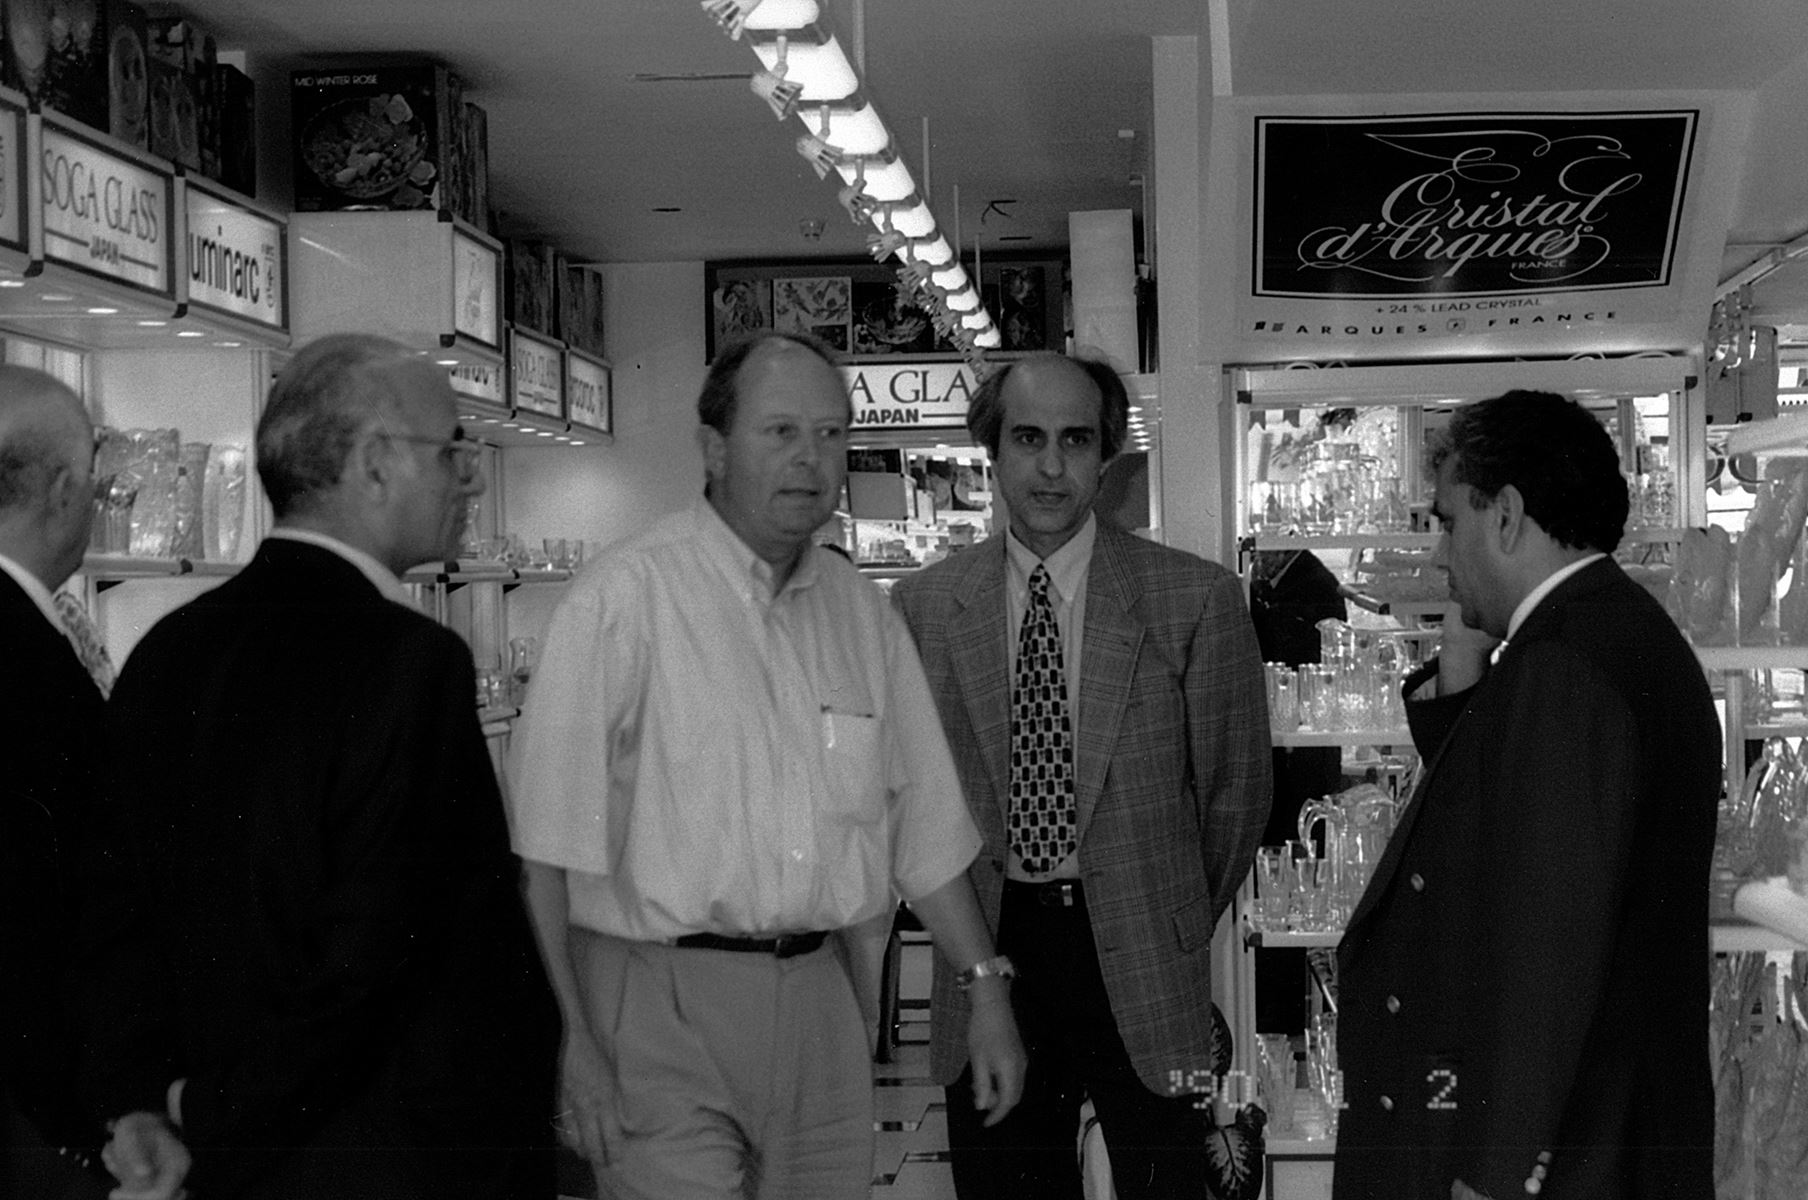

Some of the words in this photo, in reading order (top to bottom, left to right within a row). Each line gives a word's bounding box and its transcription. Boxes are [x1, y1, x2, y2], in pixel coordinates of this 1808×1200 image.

[315, 74, 351, 86] WINTER
[352, 74, 378, 85] ROSE
[43, 149, 99, 223] SOGA
[104, 175, 158, 244] GLASS
[1380, 148, 1642, 229] Cristal
[1511, 258, 1567, 271] FRANCE
[1389, 304, 1408, 314] 24
[1431, 301, 1472, 313] LEAD
[1475, 297, 1542, 311] CRYSTAL
[1296, 324, 1428, 336] ARQUES
[1488, 311, 1617, 327] FRANCE
[889, 370, 973, 403] GLA
[855, 408, 919, 424] JAPAN
